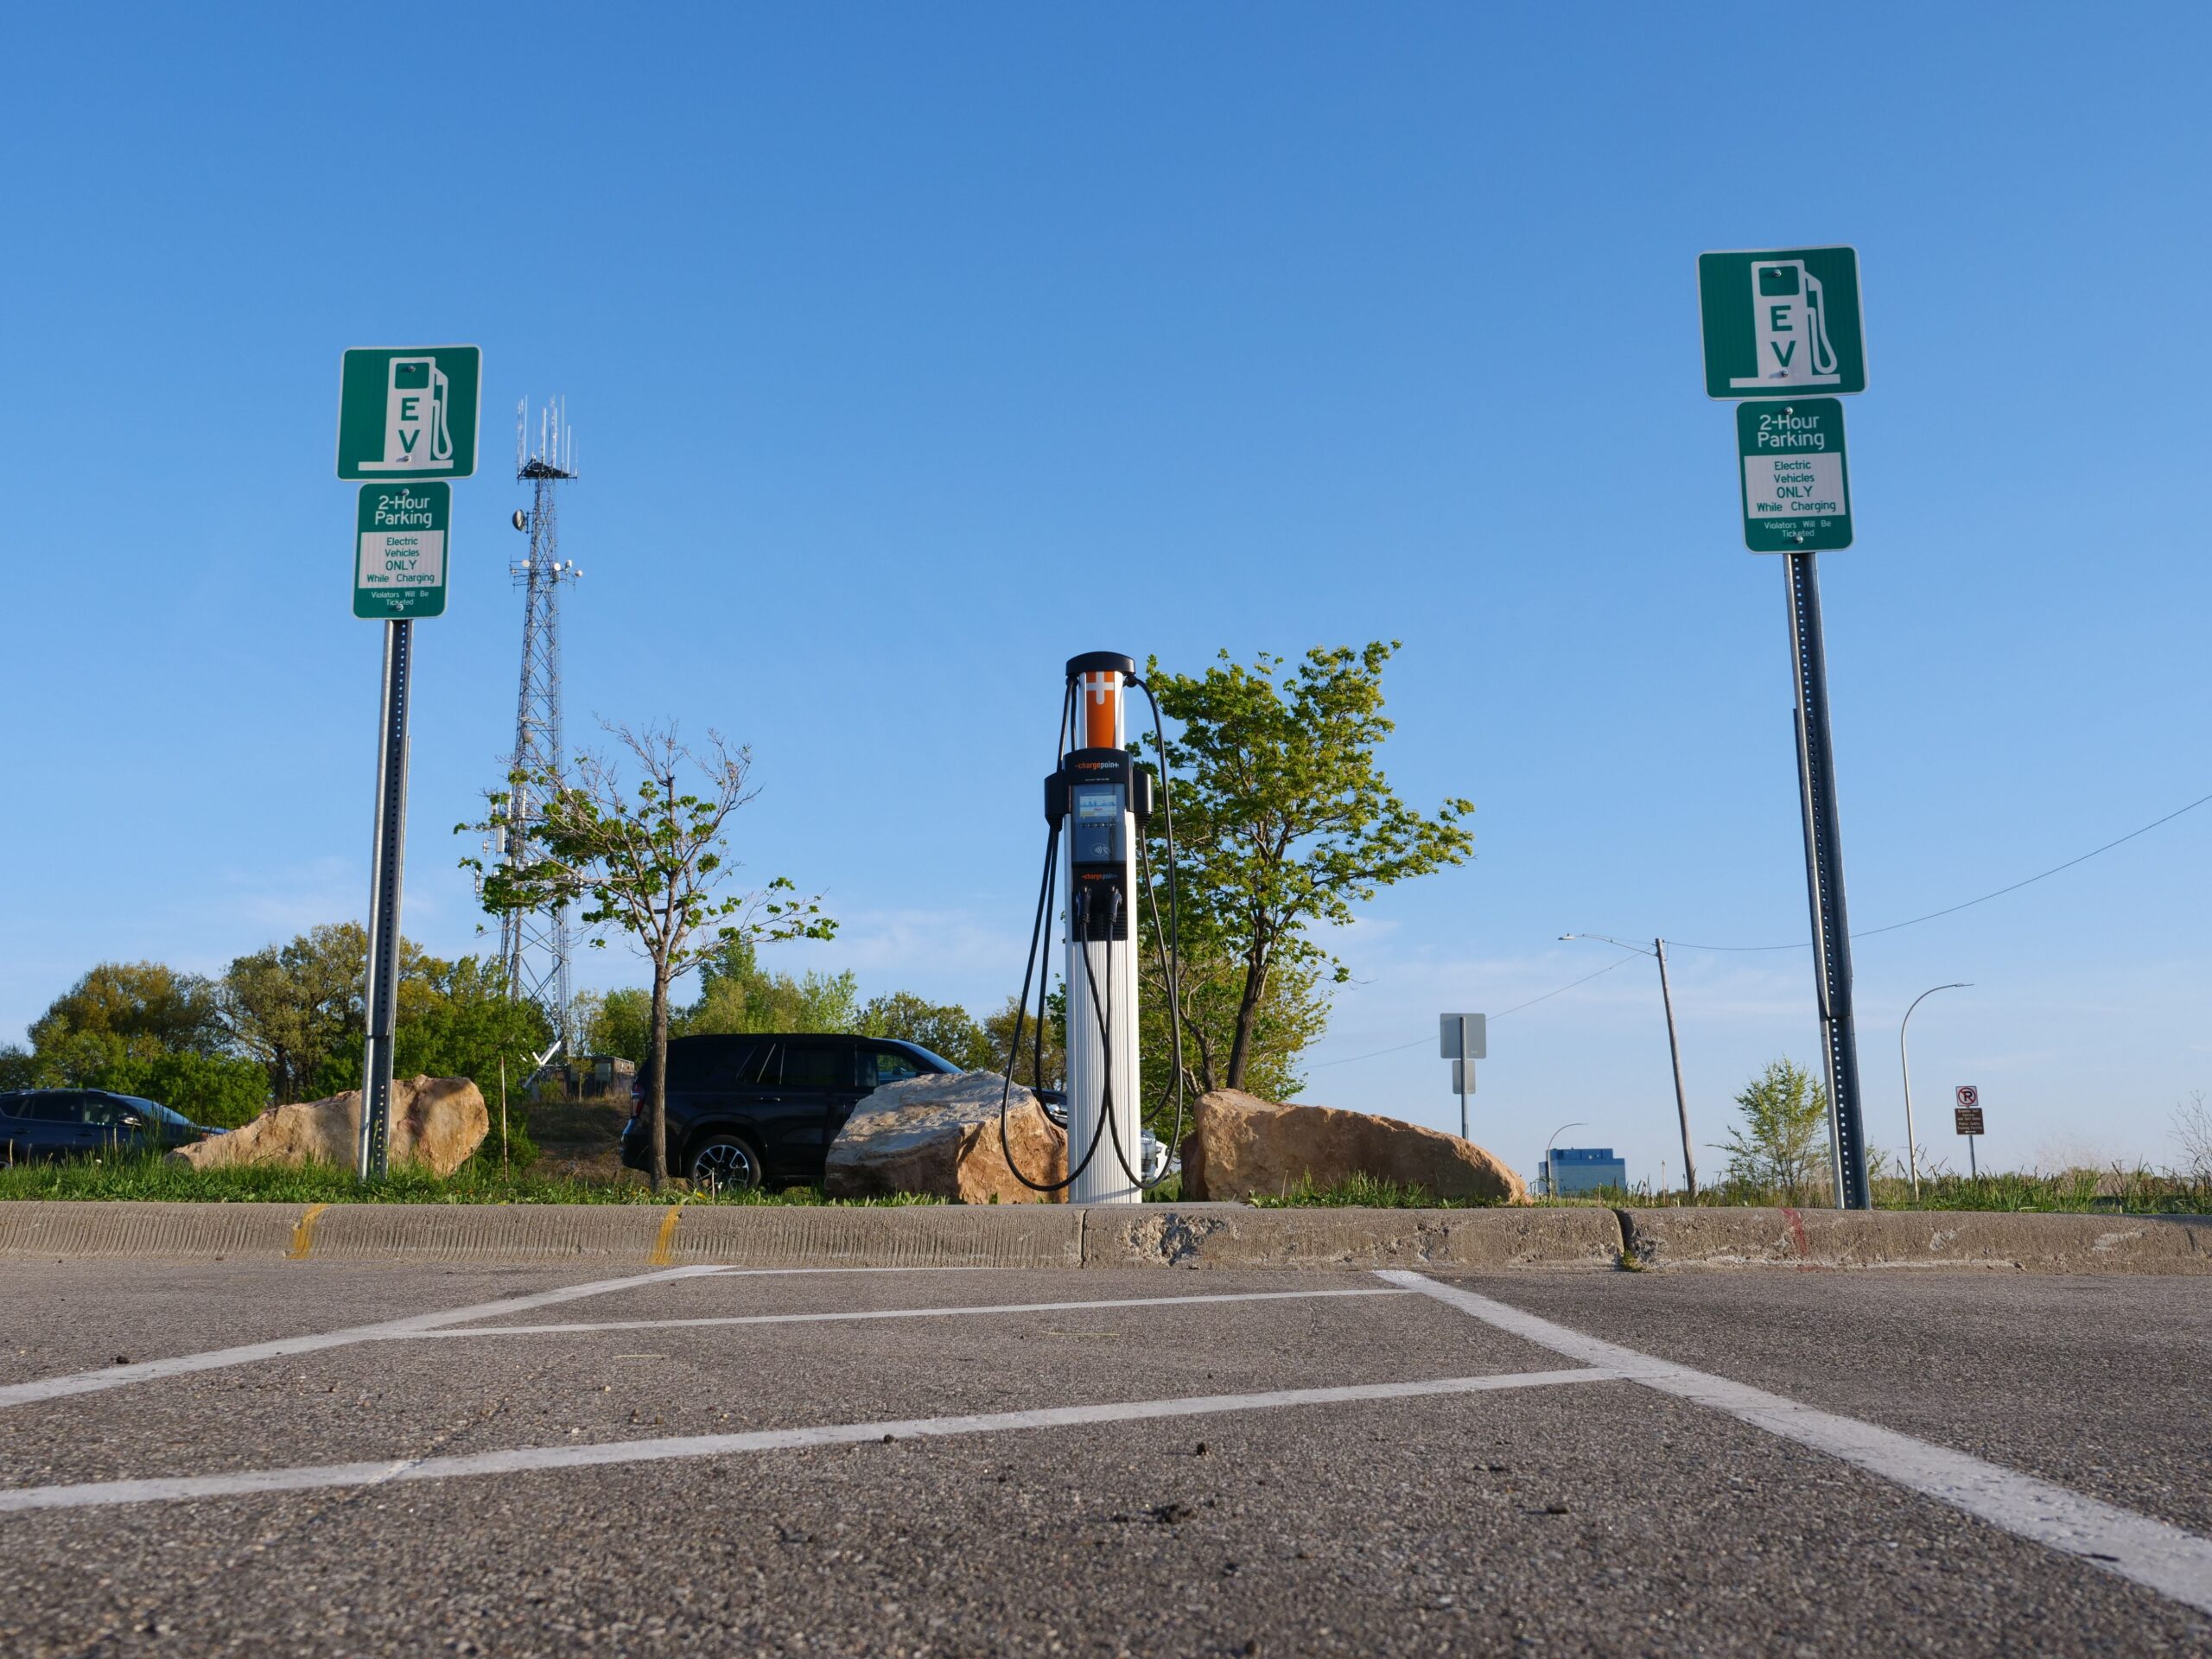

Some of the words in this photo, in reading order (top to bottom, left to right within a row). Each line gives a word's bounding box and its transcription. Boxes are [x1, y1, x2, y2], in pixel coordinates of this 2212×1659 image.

[1770, 305, 1796, 367] EV
[398, 397, 421, 453] EV
[1759, 415, 1820, 430] 2-Hour
[1758, 430, 1825, 450] Parking
[1774, 460, 1811, 470] Electric
[1774, 474, 1815, 483] Vehicles
[1777, 486, 1813, 499] ONLY
[378, 495, 430, 510] 2-Hour
[1757, 502, 1783, 512] While
[1791, 501, 1836, 512] Charging
[374, 510, 432, 529] Parking
[386, 537, 418, 545] Electric
[385, 549, 420, 557] Vehicles
[385, 560, 417, 570] ONLY
[366, 574, 390, 582] While
[396, 573, 435, 584] Charging
